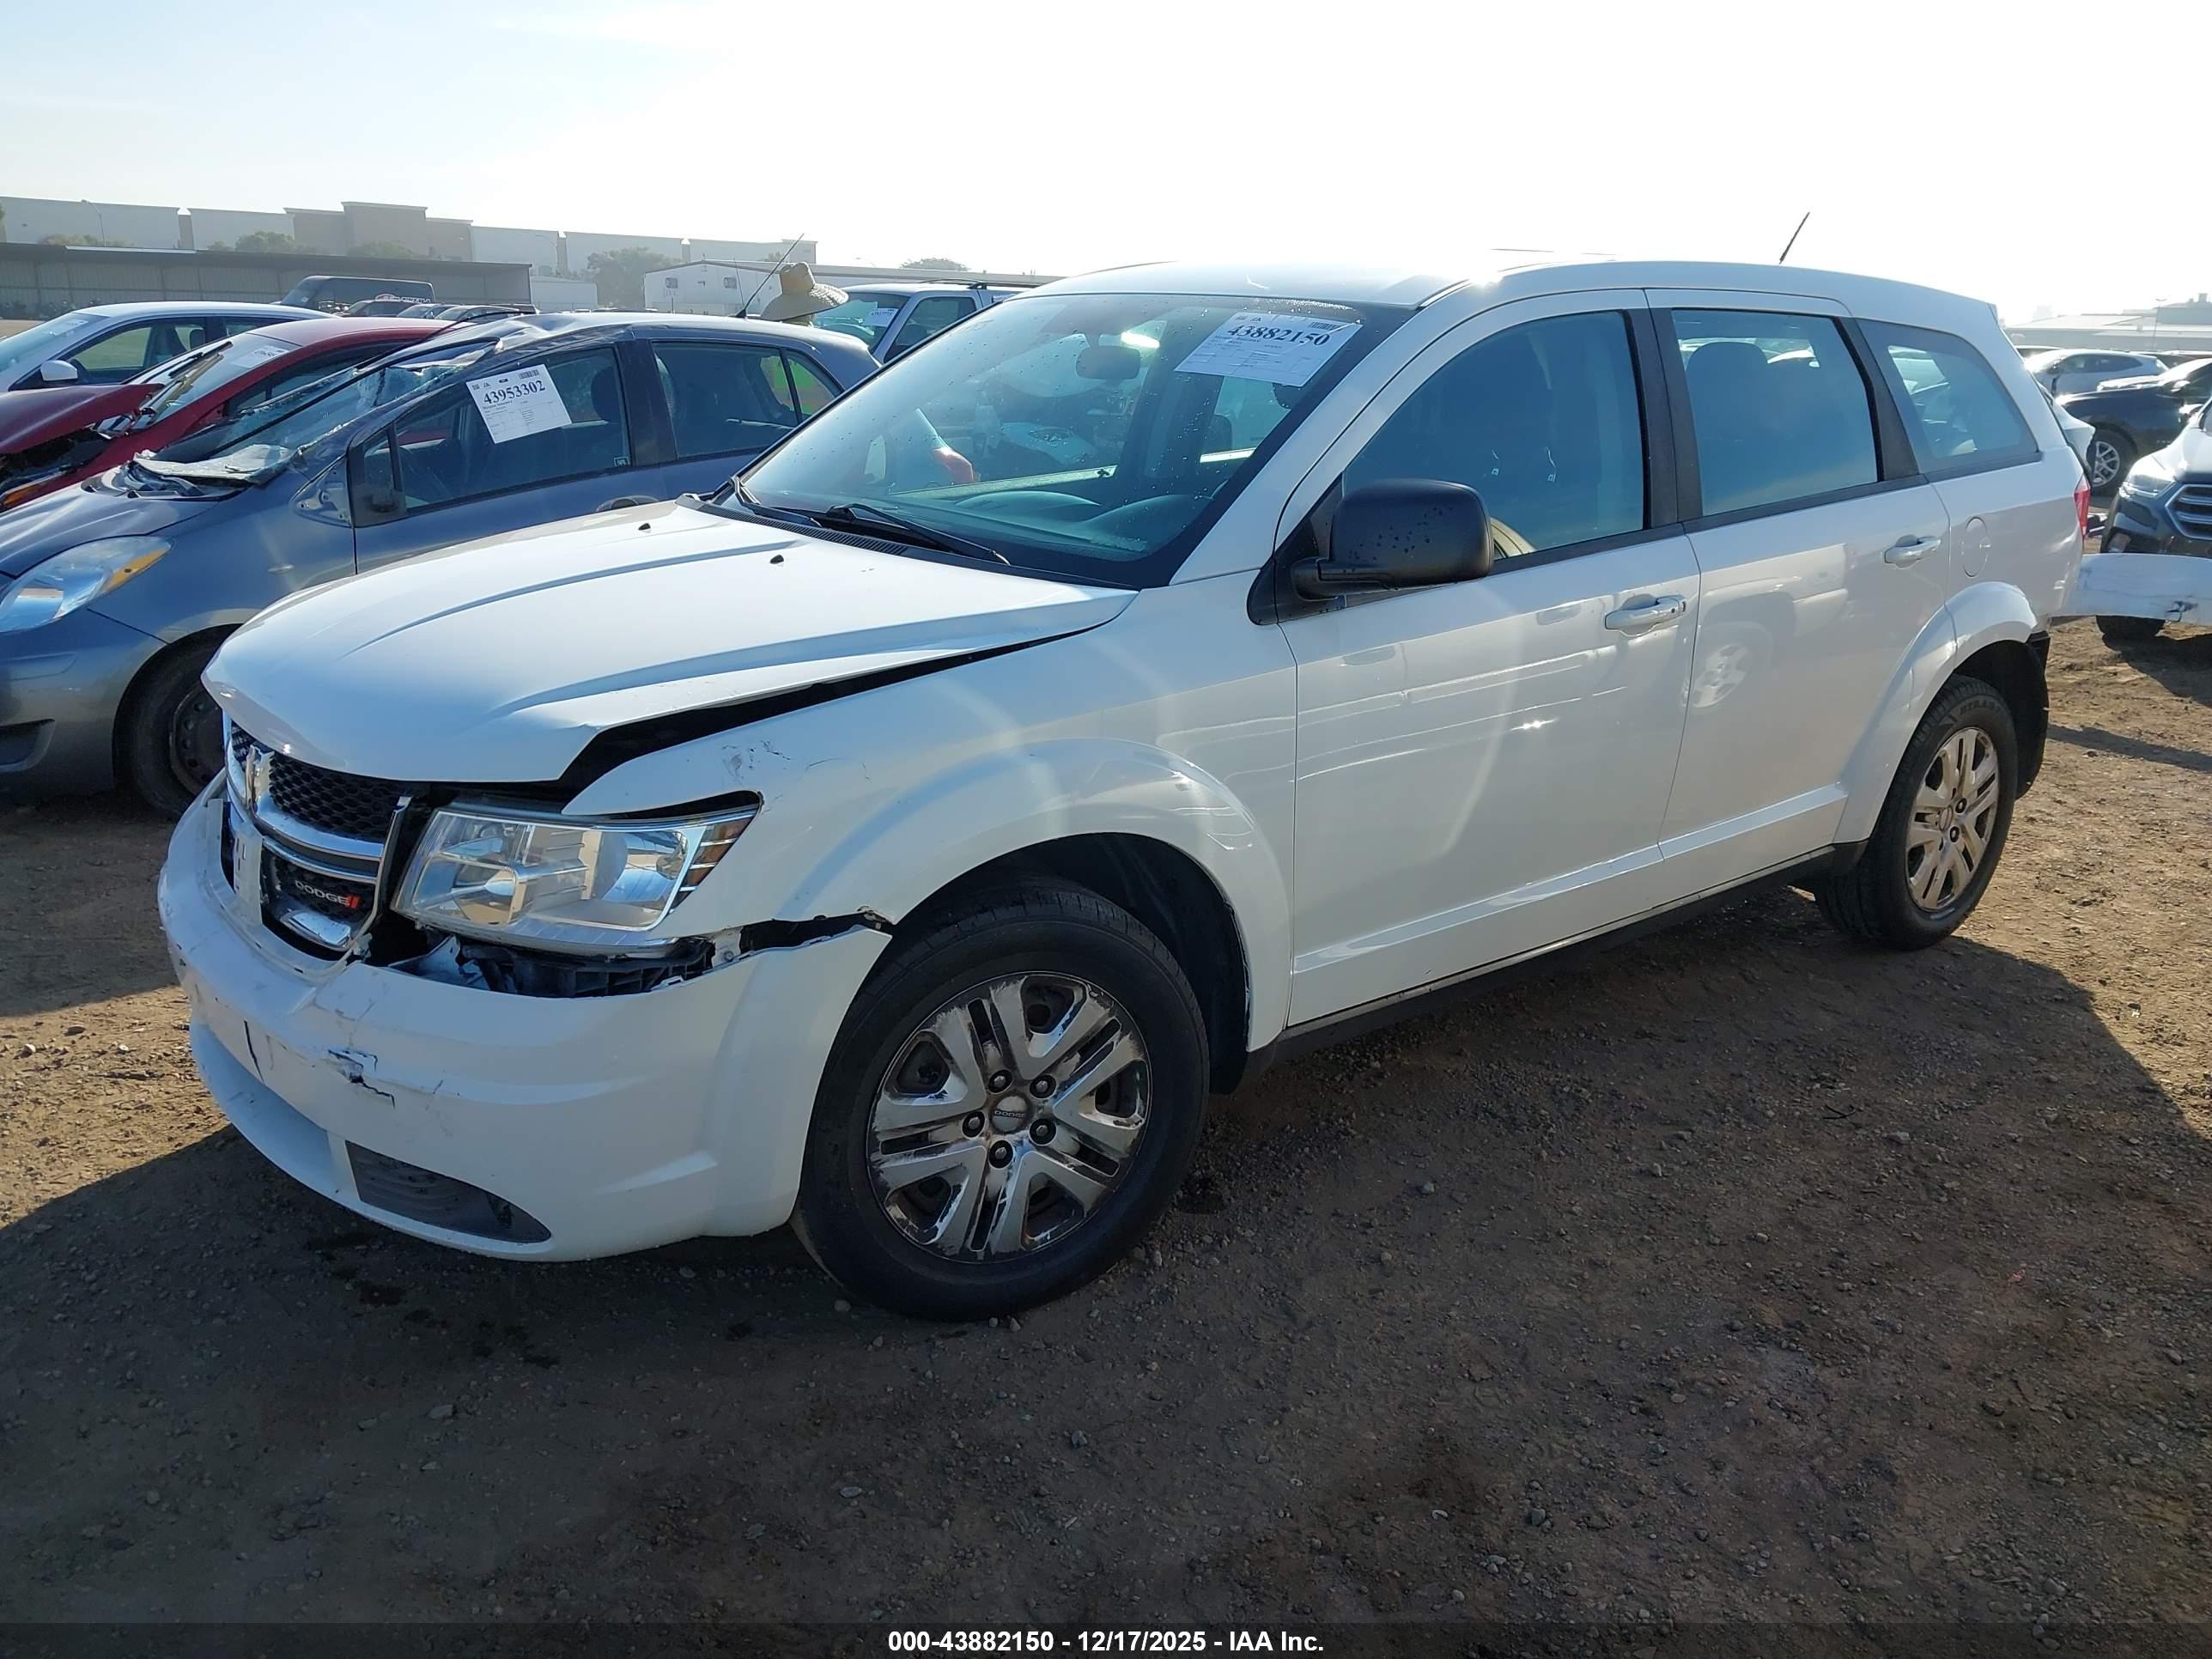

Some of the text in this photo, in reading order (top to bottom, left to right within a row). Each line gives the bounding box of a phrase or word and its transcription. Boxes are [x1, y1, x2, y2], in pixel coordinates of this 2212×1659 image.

[1227, 325, 1331, 346] 43882150
[483, 380, 546, 404] 43953302
[295, 879, 350, 906] DODGE
